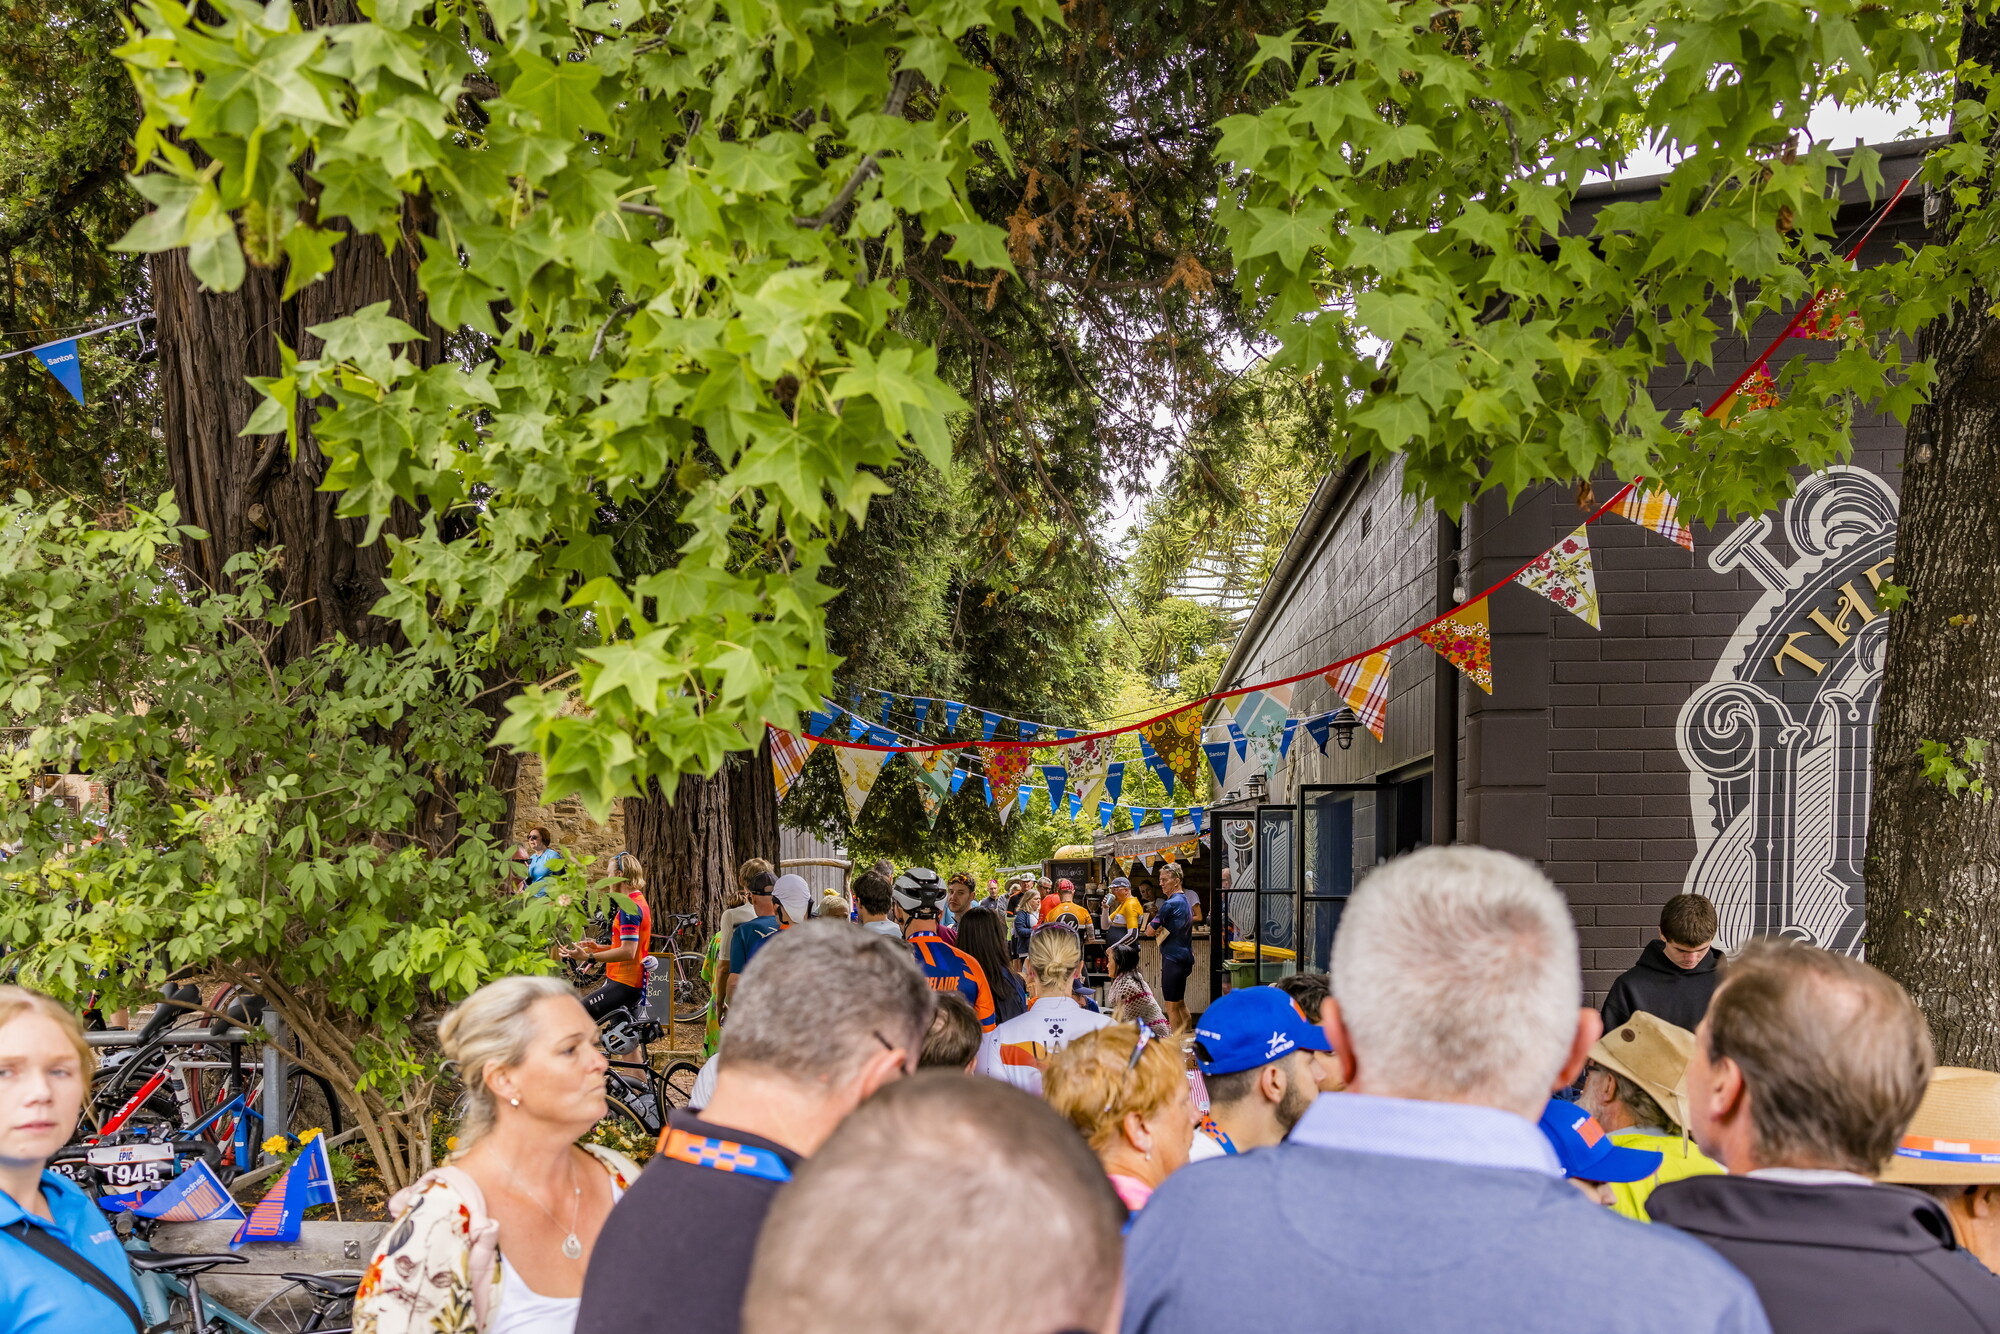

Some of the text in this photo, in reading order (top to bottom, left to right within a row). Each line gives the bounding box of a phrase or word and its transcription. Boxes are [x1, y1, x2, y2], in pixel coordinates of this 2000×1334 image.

[47, 353, 75, 366] Santos
[871, 734, 890, 745] Santos
[648, 971, 670, 982] Shed
[926, 976, 960, 991] ELAIDE
[646, 986, 662, 997] Bar
[589, 994, 605, 1005] MAAP
[118, 1151, 133, 1161] EPIC
[102, 1162, 160, 1185] 1945
